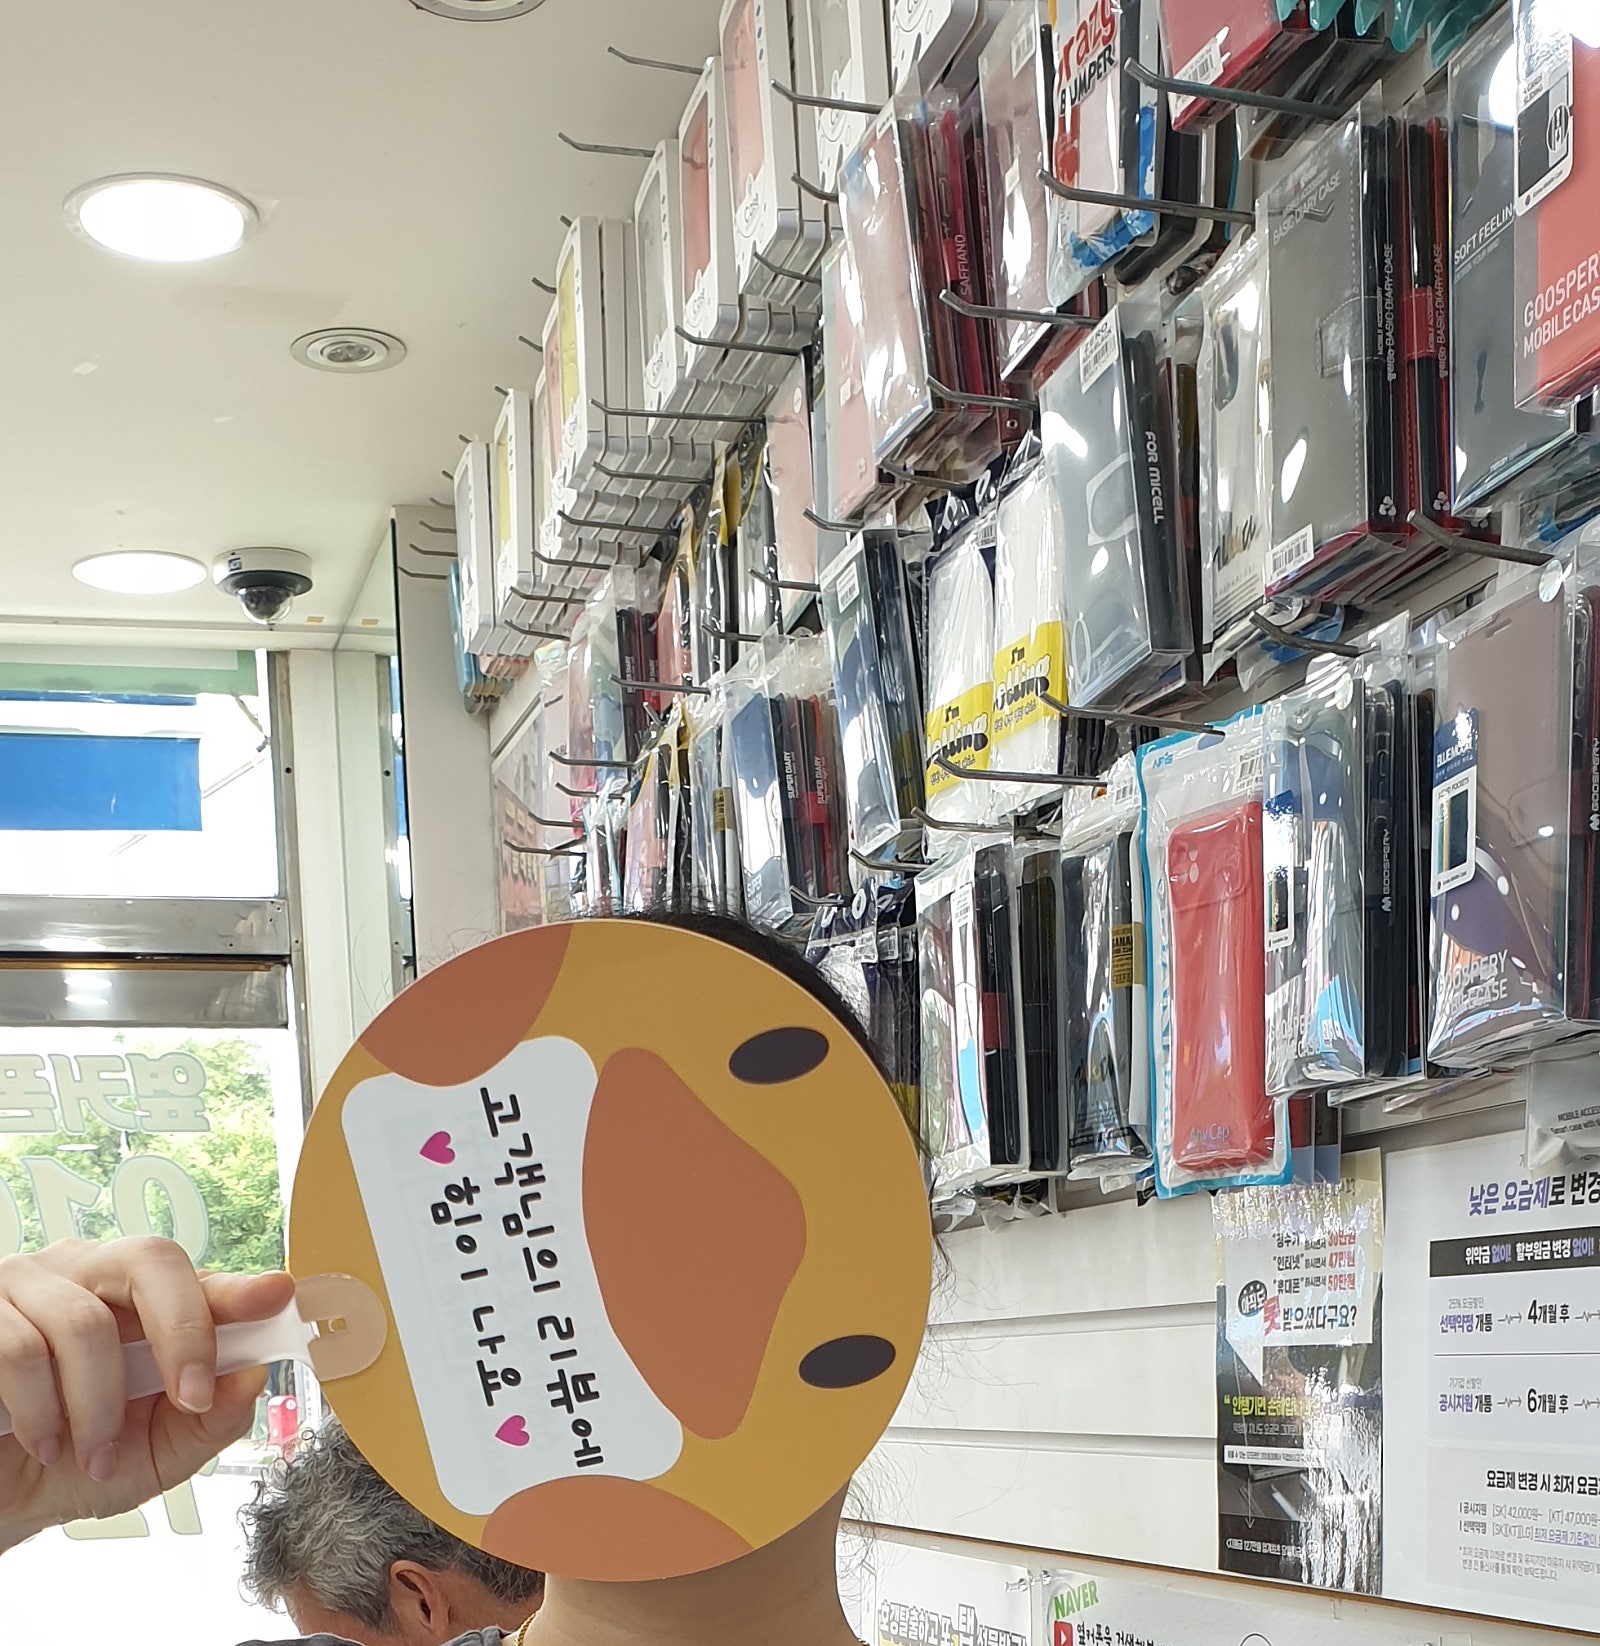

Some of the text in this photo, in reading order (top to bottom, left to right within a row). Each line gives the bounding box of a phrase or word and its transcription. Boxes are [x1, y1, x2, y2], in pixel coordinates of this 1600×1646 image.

[1058, 0, 1118, 95] razy
[1060, 44, 1115, 116] BUMPER
[1454, 233, 1477, 265] SOFT
[1478, 202, 1514, 244] FEELIN
[955, 234, 971, 296] SAFFIANO
[1384, 243, 1393, 273] CASE
[1433, 243, 1442, 272] CASE
[1384, 275, 1394, 306] DIARY
[1435, 275, 1444, 308] DIARY
[1524, 249, 1600, 328] GOOSPER
[1145, 431, 1158, 463] FOR
[1591, 737, 1600, 812] GOOSPERY
[1382, 828, 1391, 895] GOOSPERY
[1469, 1171, 1600, 1216] 낮은 요금제로 변경
[1465, 1237, 1595, 1266] 위약금 없이! 할부원금 변경 없이!
[430, 1176, 523, 1407] 힘이 나요
[479, 1086, 604, 1468] 고객님의 리뷰에
[1440, 1300, 1570, 1333] 선택약정 개통 4개월 후
[1439, 1388, 1569, 1414] 공시지원 개통 6개월 후
[1487, 1470, 1600, 1496] 요금제 변경 시 최저 요금
[1053, 1580, 1099, 1620] NAVER
